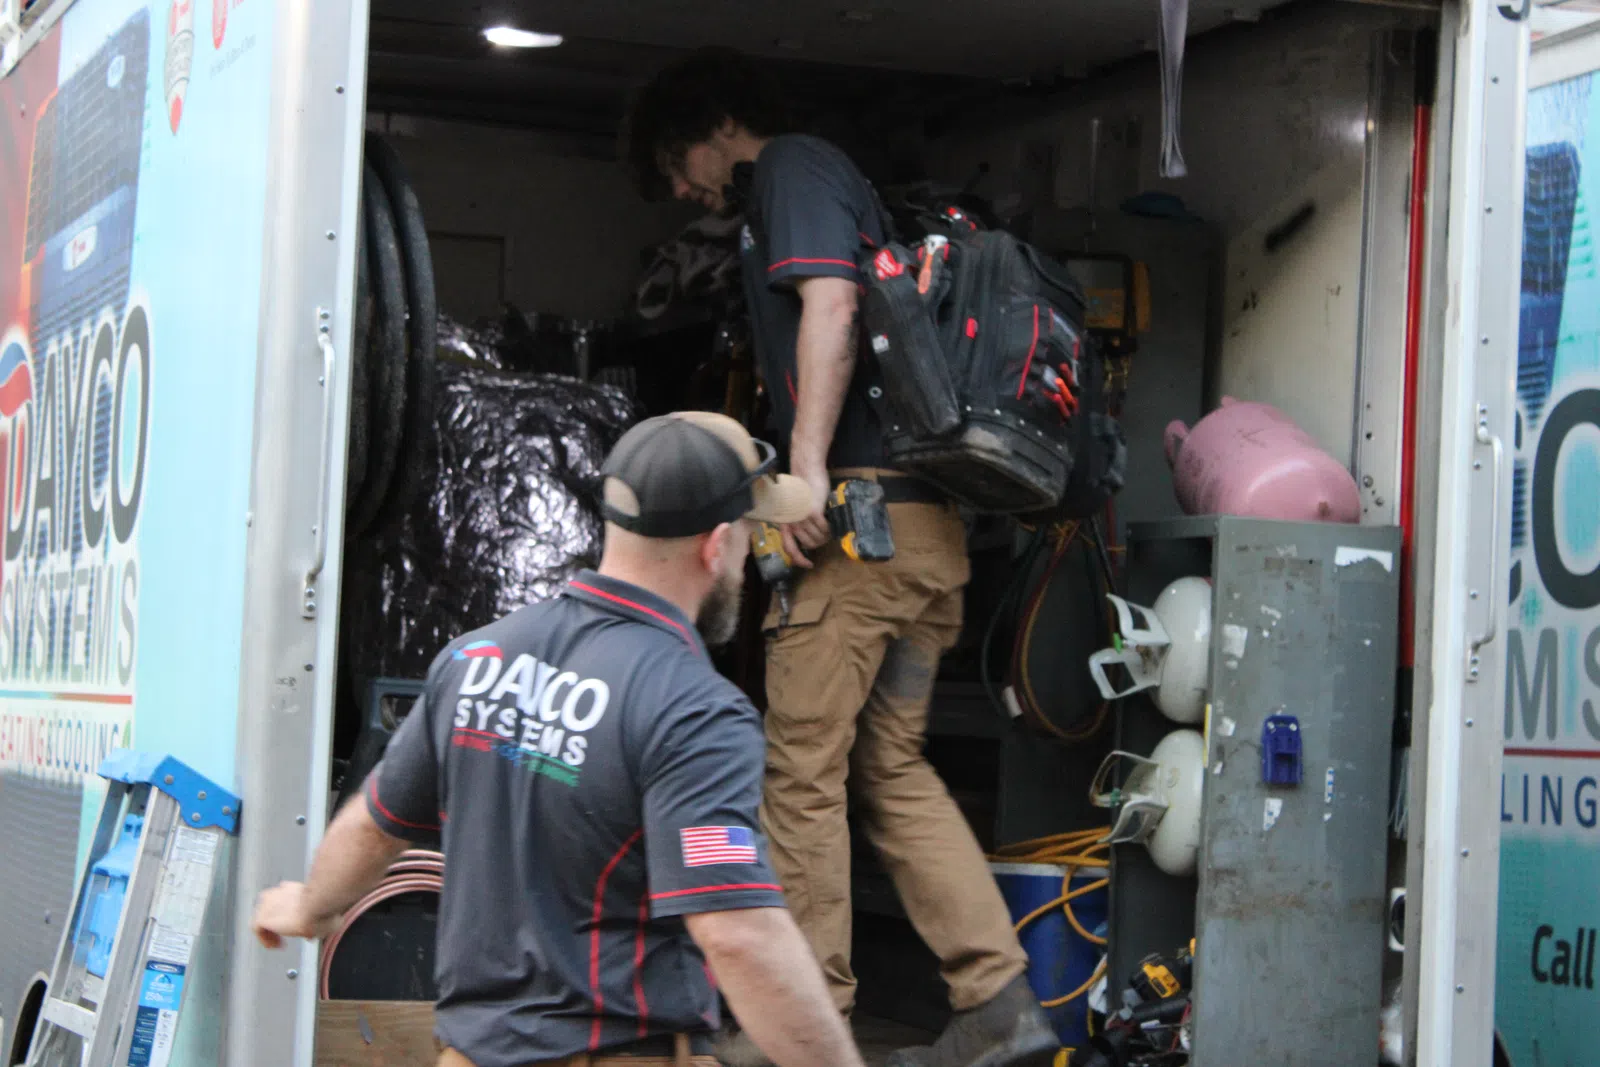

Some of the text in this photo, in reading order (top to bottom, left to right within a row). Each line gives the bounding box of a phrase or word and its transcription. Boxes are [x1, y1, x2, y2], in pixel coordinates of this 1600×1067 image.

[3, 305, 150, 561] DAYCO
[0, 559, 137, 687] SYSTEMS
[453, 697, 588, 766] SYSEMS
[458, 652, 610, 732] DAYCO
[1531, 924, 1597, 990] Call
